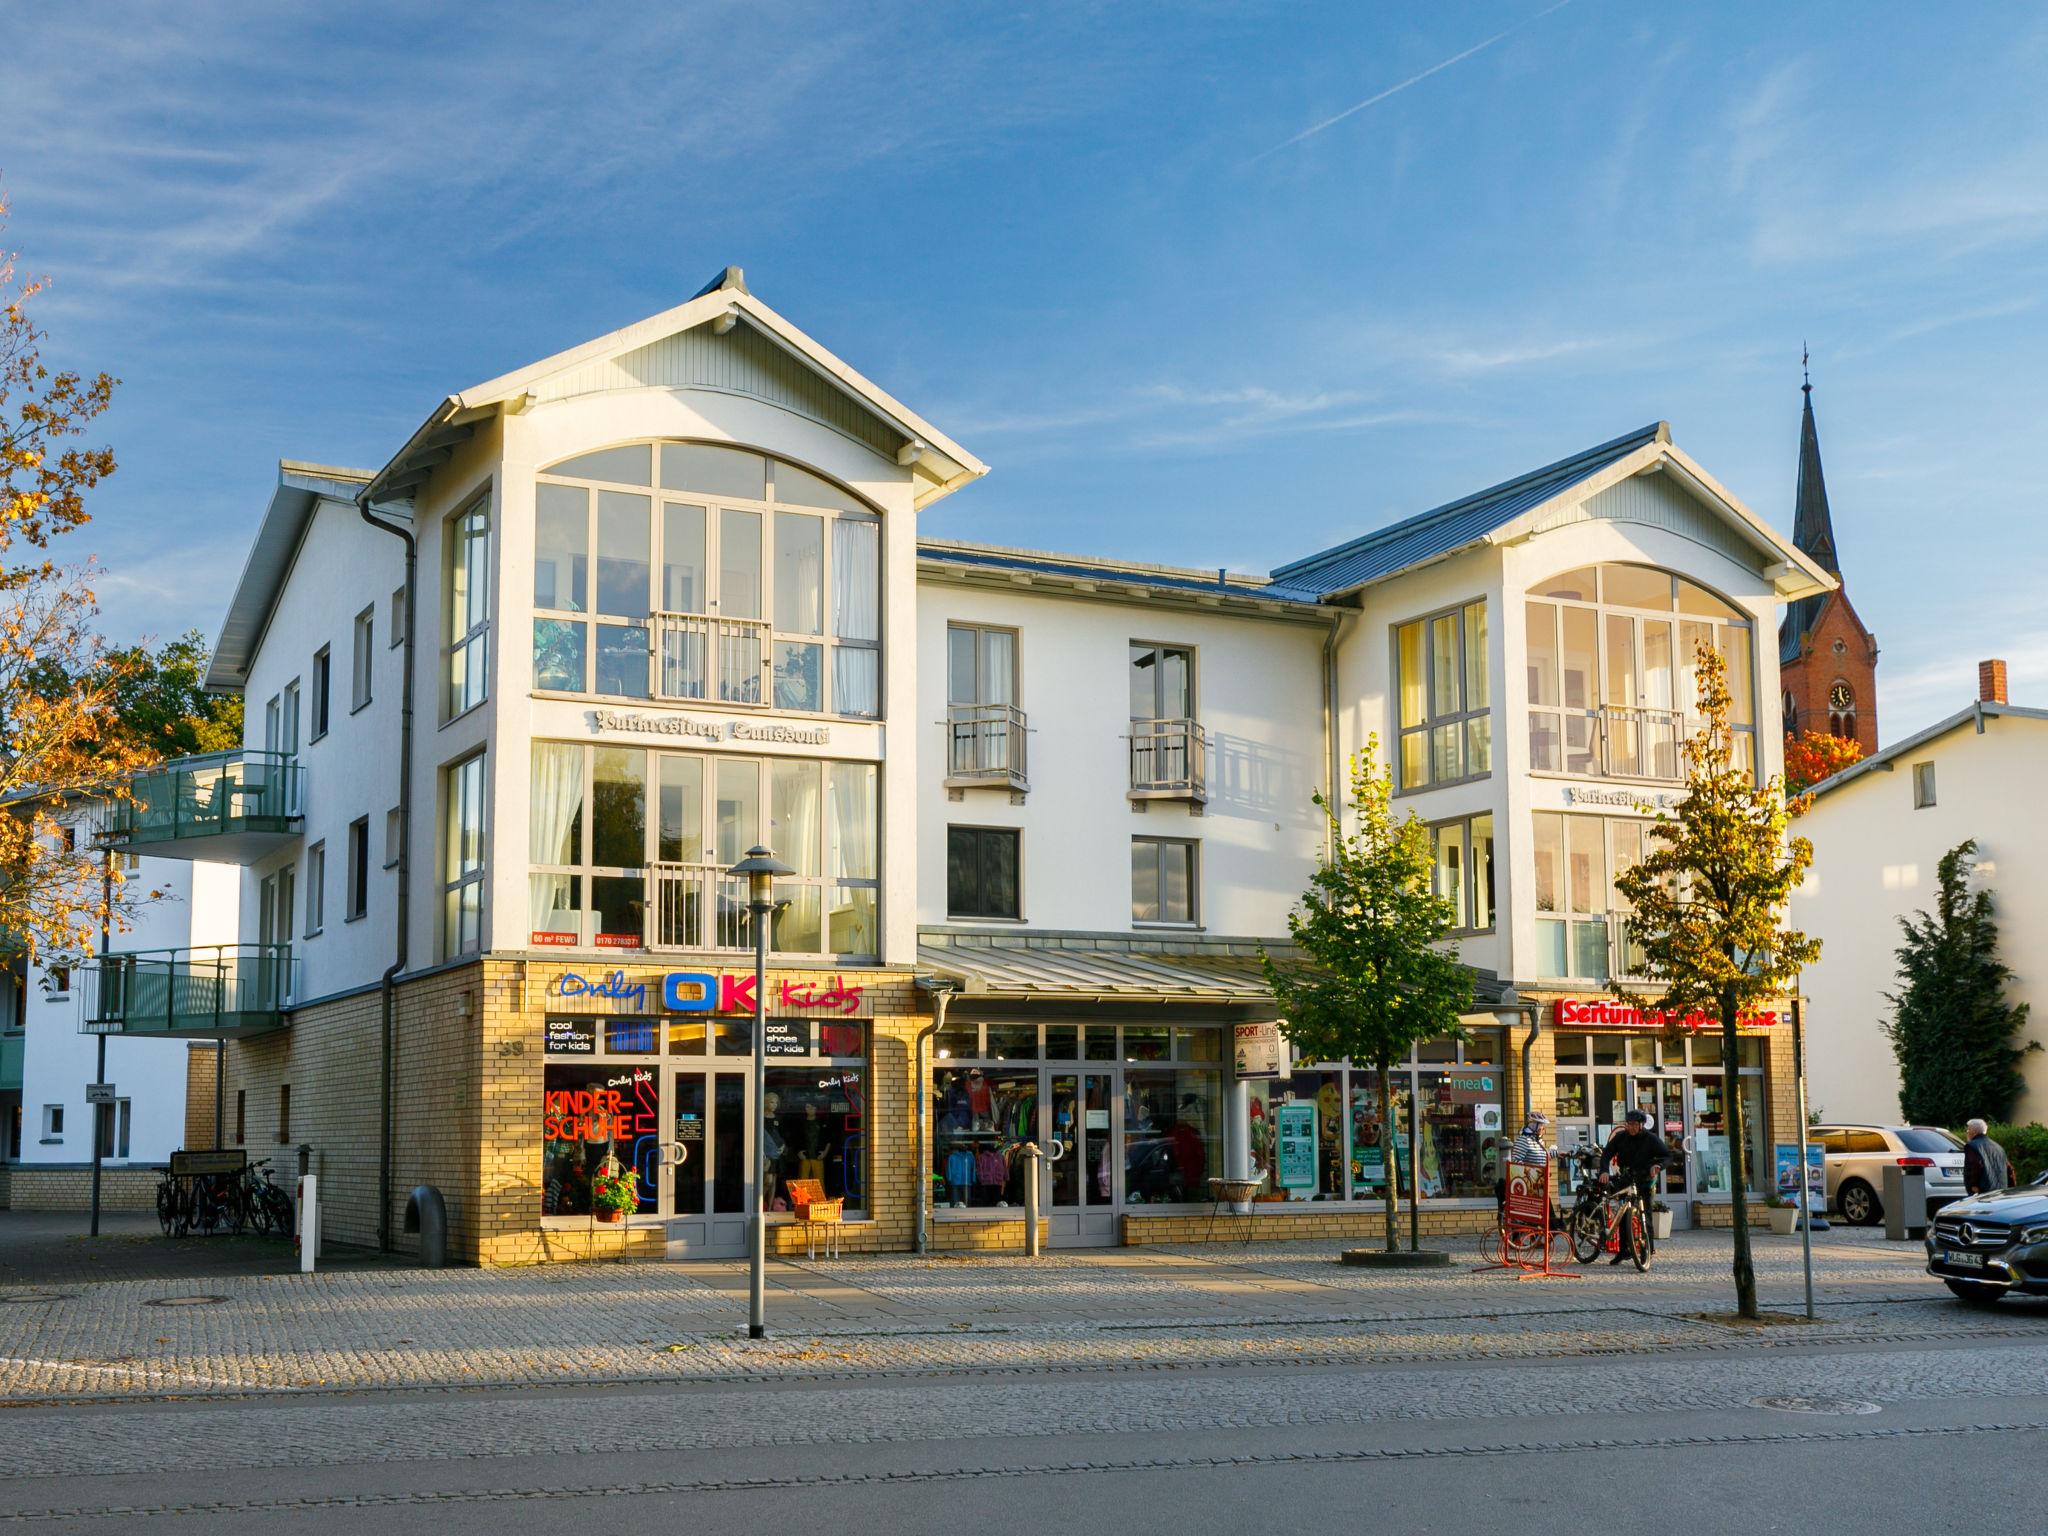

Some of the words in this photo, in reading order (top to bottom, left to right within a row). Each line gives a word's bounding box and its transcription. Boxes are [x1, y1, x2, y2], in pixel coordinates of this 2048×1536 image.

[596, 710, 726, 742] Parkresidenz
[733, 721, 830, 745] Sanssouci
[533, 934, 543, 943] 60
[555, 935, 576, 944] FEWO
[596, 937, 611, 945] 0170
[560, 970, 645, 1011] Only
[662, 972, 770, 1012] OK
[781, 975, 863, 1014] Kids
[549, 1021, 573, 1030] cool
[766, 1024, 788, 1033] cool
[549, 1031, 589, 1040] fashion
[1235, 1025, 1258, 1037] SPORT
[766, 1034, 798, 1043] shoes
[549, 1041, 567, 1050] for
[568, 1041, 591, 1051] kids
[766, 1043, 782, 1053] for
[783, 1044, 805, 1053] kids
[608, 1074, 632, 1087] Only
[818, 1077, 841, 1088] Only
[1452, 1079, 1481, 1090] mea
[545, 1090, 634, 1115] KINDER-
[544, 1115, 633, 1141] SCHUHE
